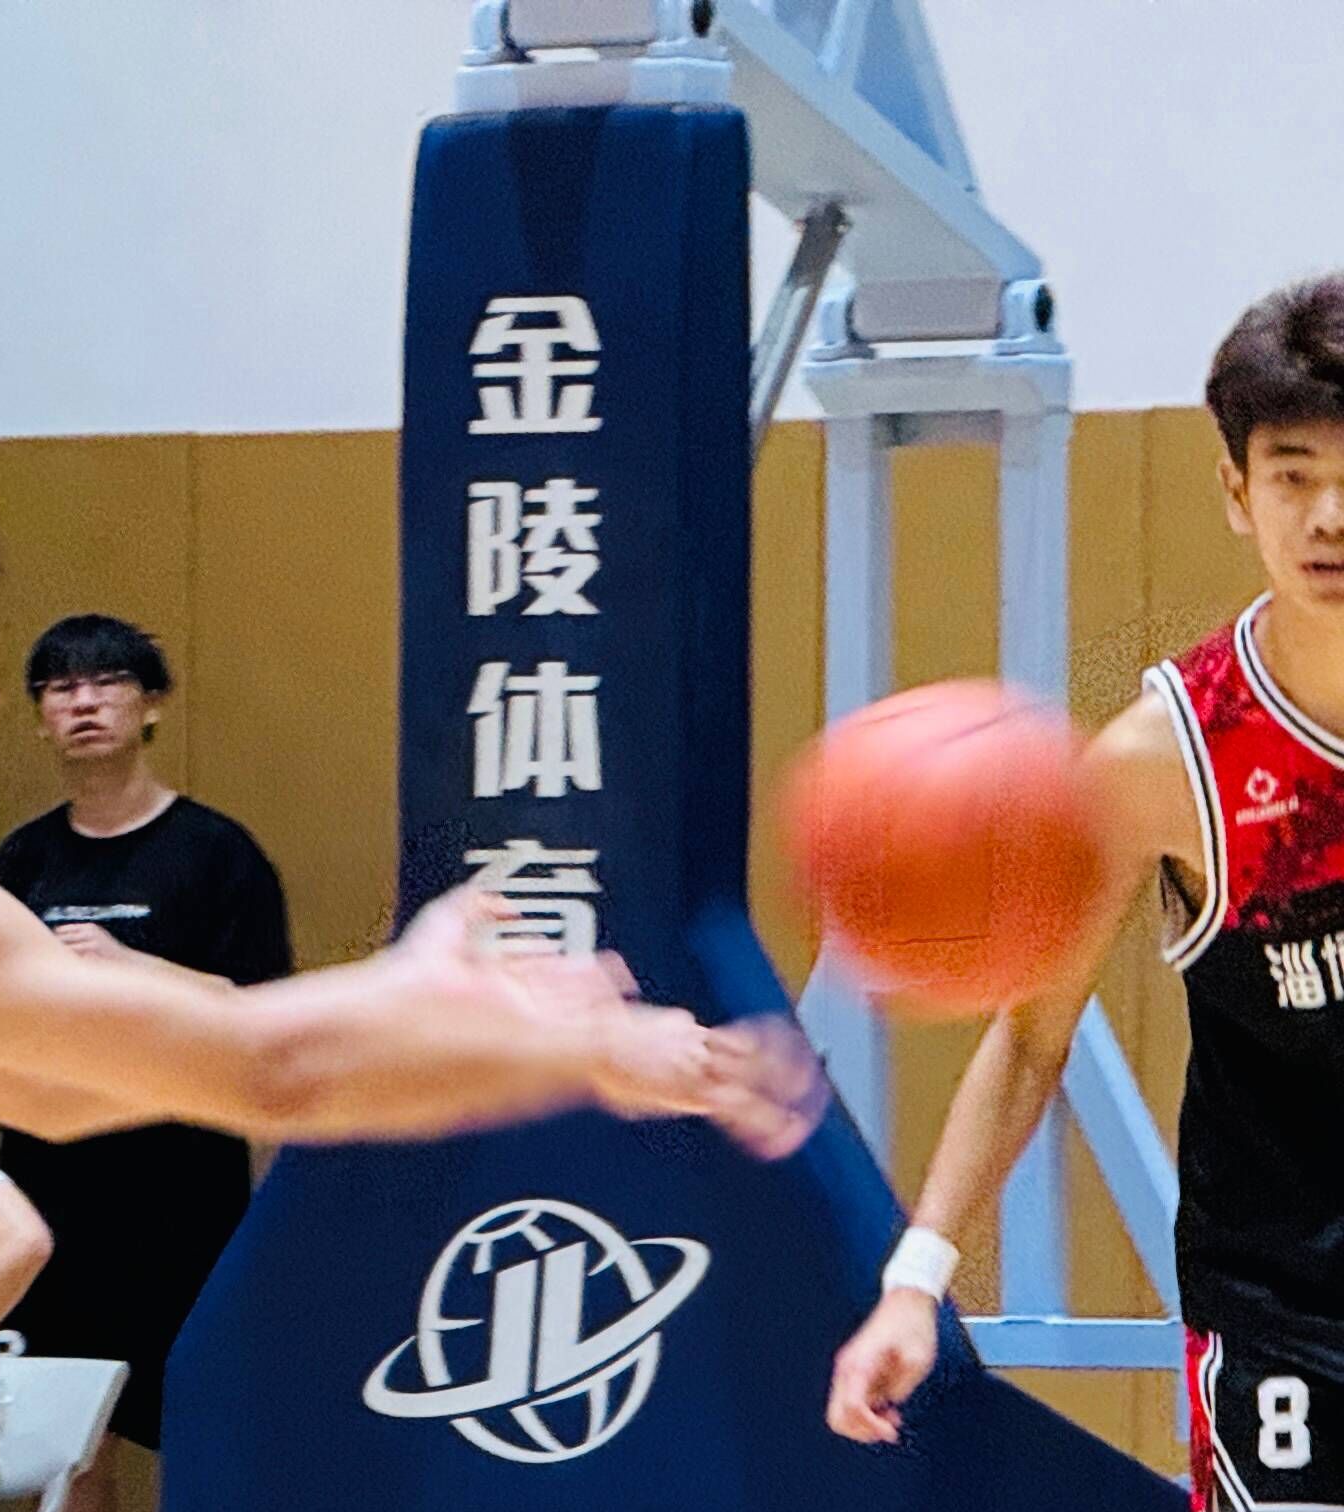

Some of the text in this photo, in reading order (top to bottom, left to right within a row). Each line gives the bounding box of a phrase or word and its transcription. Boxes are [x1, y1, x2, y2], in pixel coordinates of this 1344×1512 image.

[464, 294, 605, 962] 金陵体育
[1257, 1376, 1311, 1470] 8
